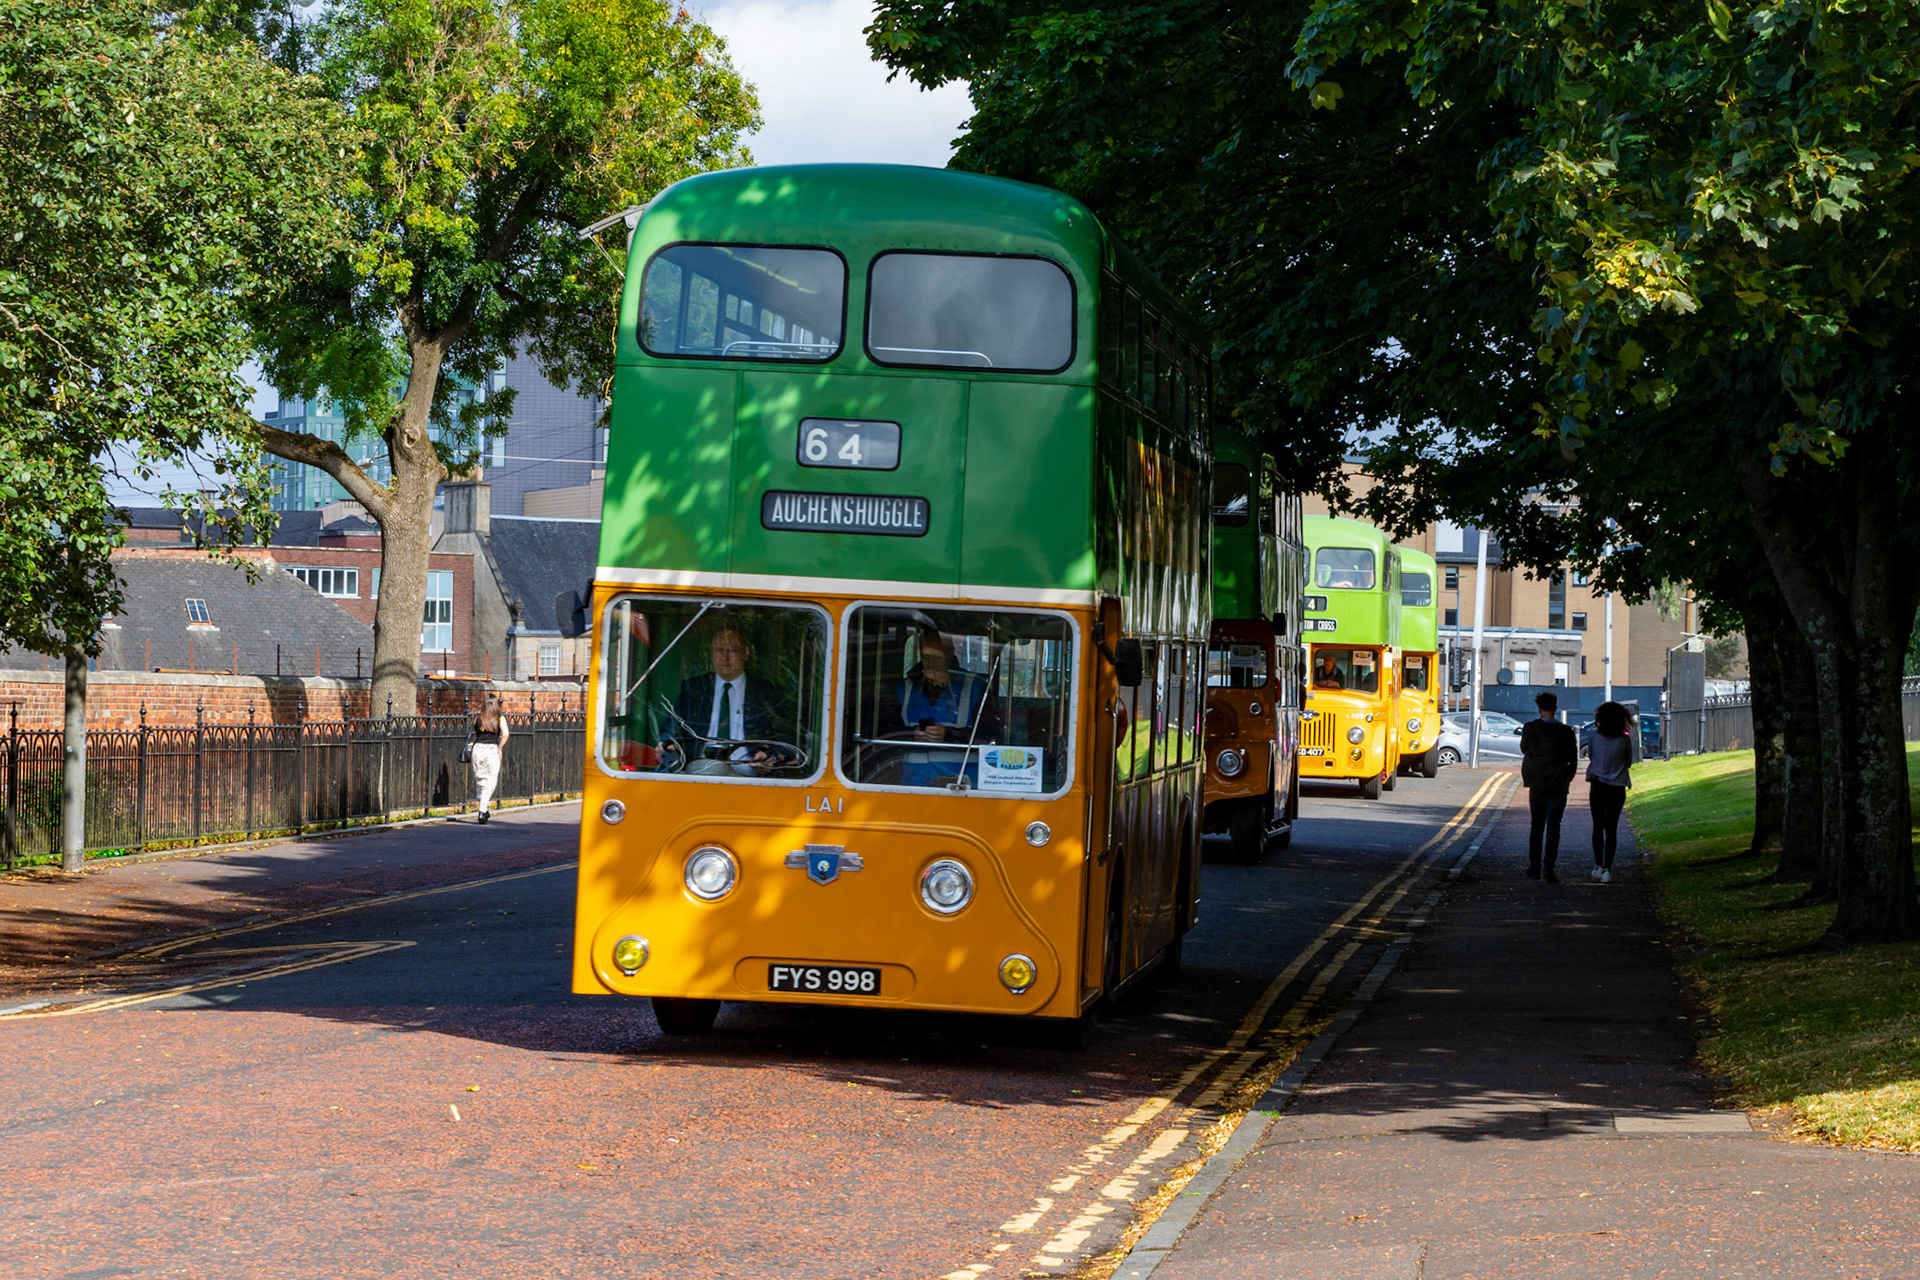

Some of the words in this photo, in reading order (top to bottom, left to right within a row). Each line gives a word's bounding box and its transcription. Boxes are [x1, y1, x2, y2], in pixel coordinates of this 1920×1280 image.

[805, 428, 862, 465] 64
[772, 494, 922, 528] AUCHENSHUGGLE
[1308, 598, 1315, 610] 4
[1318, 620, 1335, 631] CROSS
[1001, 749, 1024, 764] 100
[1307, 748, 1323, 756] 407
[773, 967, 821, 990] FYS
[827, 970, 875, 992] 998
